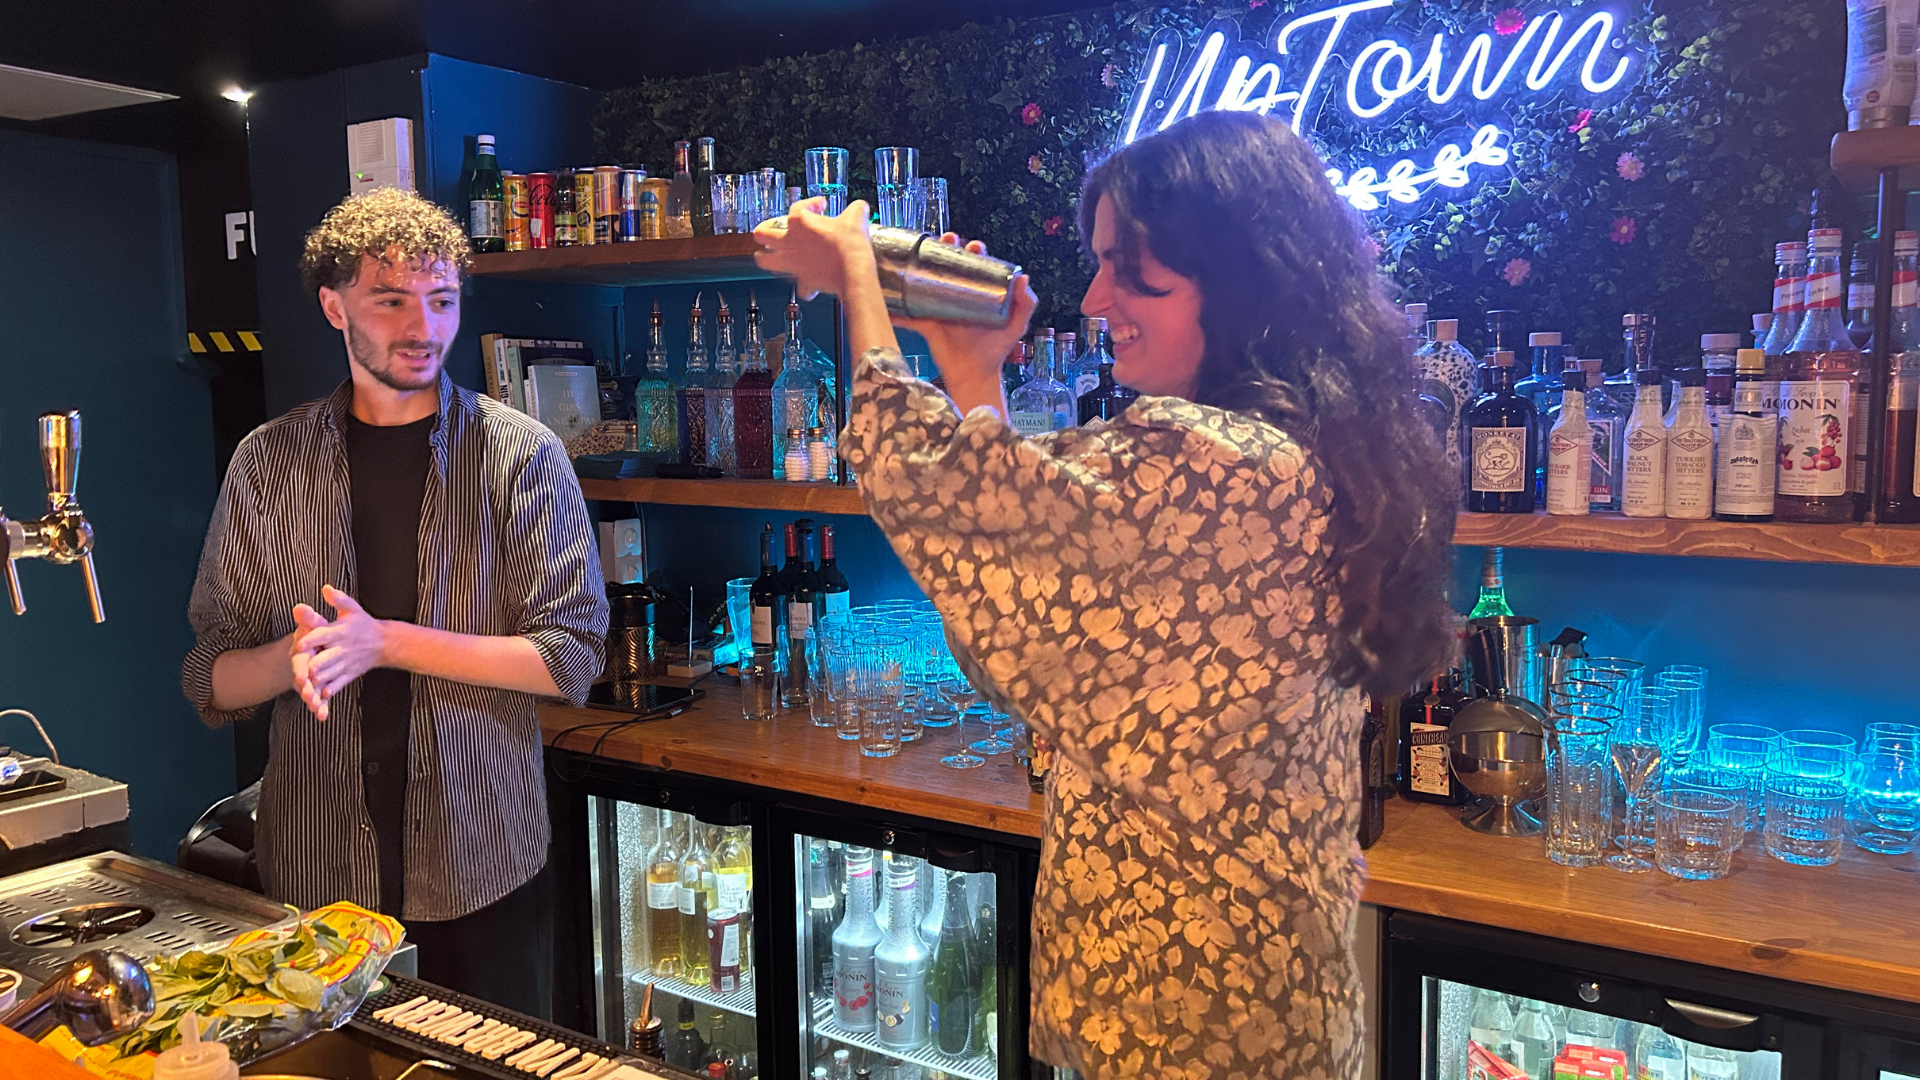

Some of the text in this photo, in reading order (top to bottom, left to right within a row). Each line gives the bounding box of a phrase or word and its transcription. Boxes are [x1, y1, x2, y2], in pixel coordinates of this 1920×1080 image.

[500, 384, 510, 399] GIN
[1779, 398, 1838, 410] MONIN
[1476, 430, 1510, 440] MONKEY
[372, 995, 538, 1061] BREWERY
